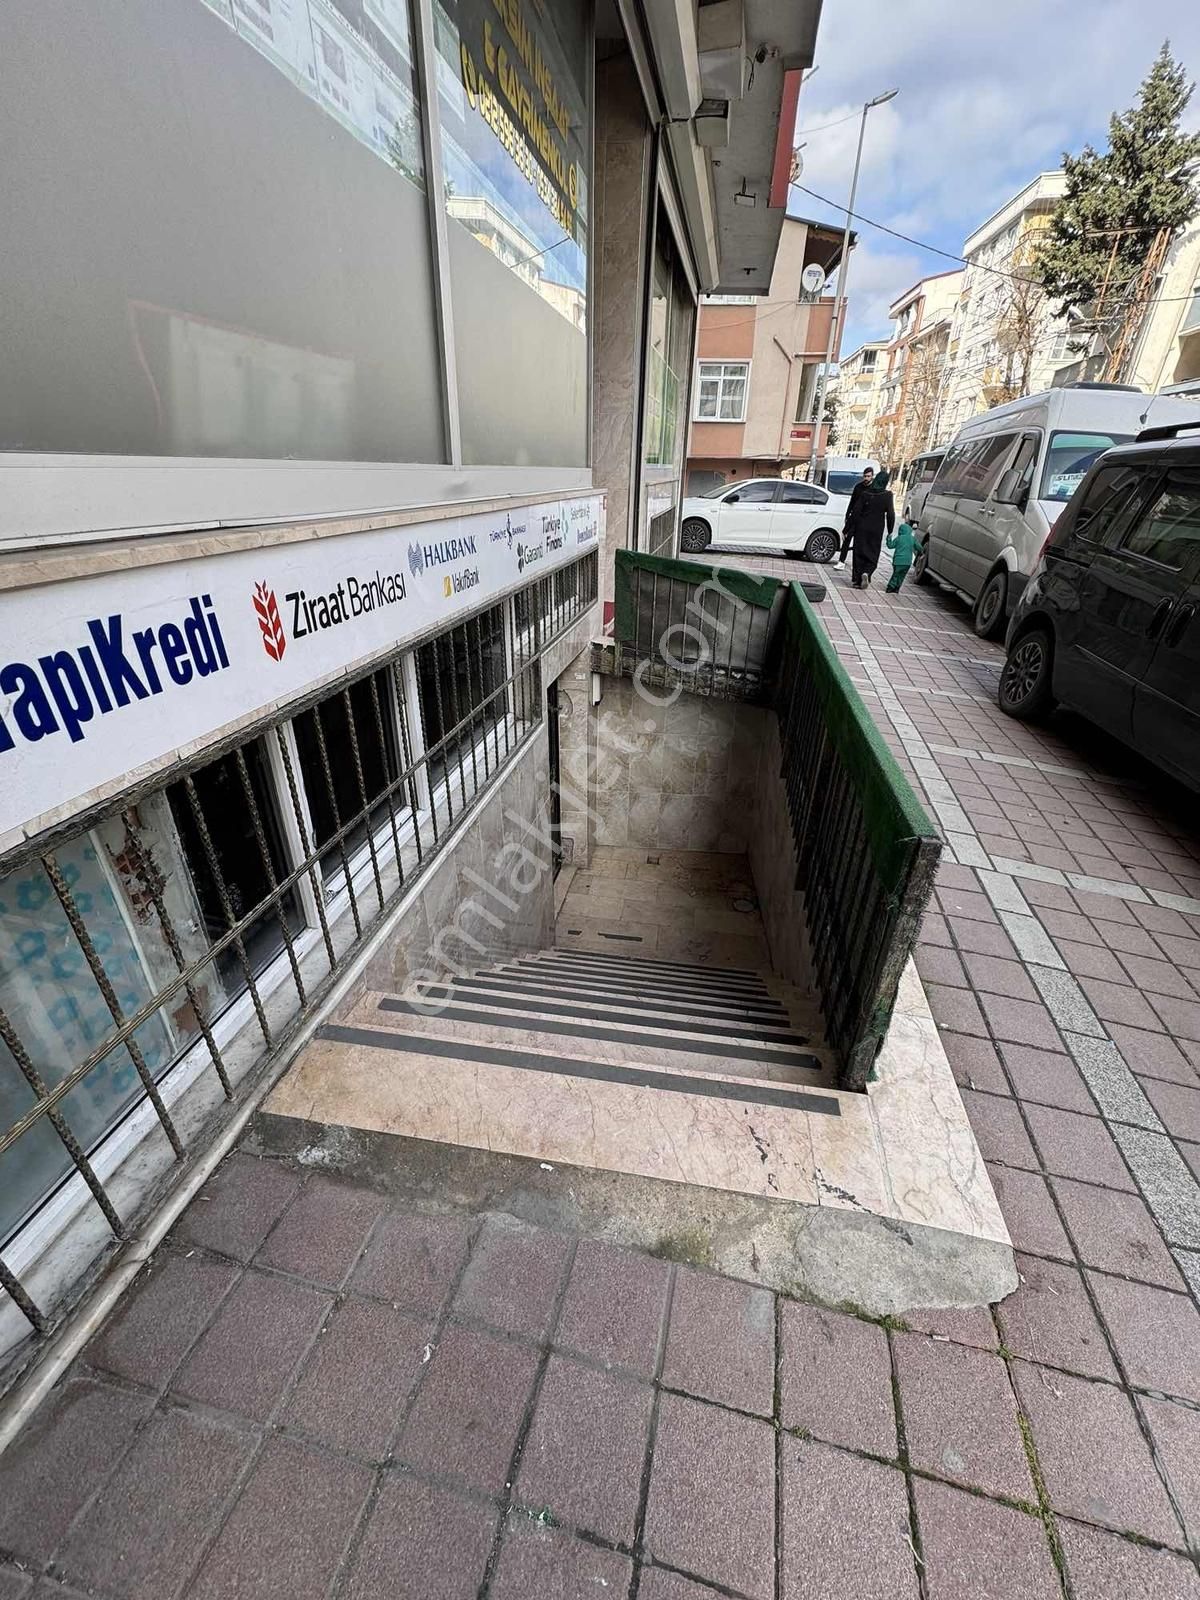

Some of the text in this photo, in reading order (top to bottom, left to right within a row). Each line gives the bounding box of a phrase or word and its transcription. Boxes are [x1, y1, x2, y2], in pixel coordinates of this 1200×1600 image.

[497, 45, 569, 195] GAYRİMENKUL
[542, 515, 561, 536] Türkiye
[423, 535, 477, 568] HALKBANK
[524, 542, 543, 565] Garanti
[546, 535, 563, 553] Finans
[285, 570, 407, 639] Ziraat Bankası
